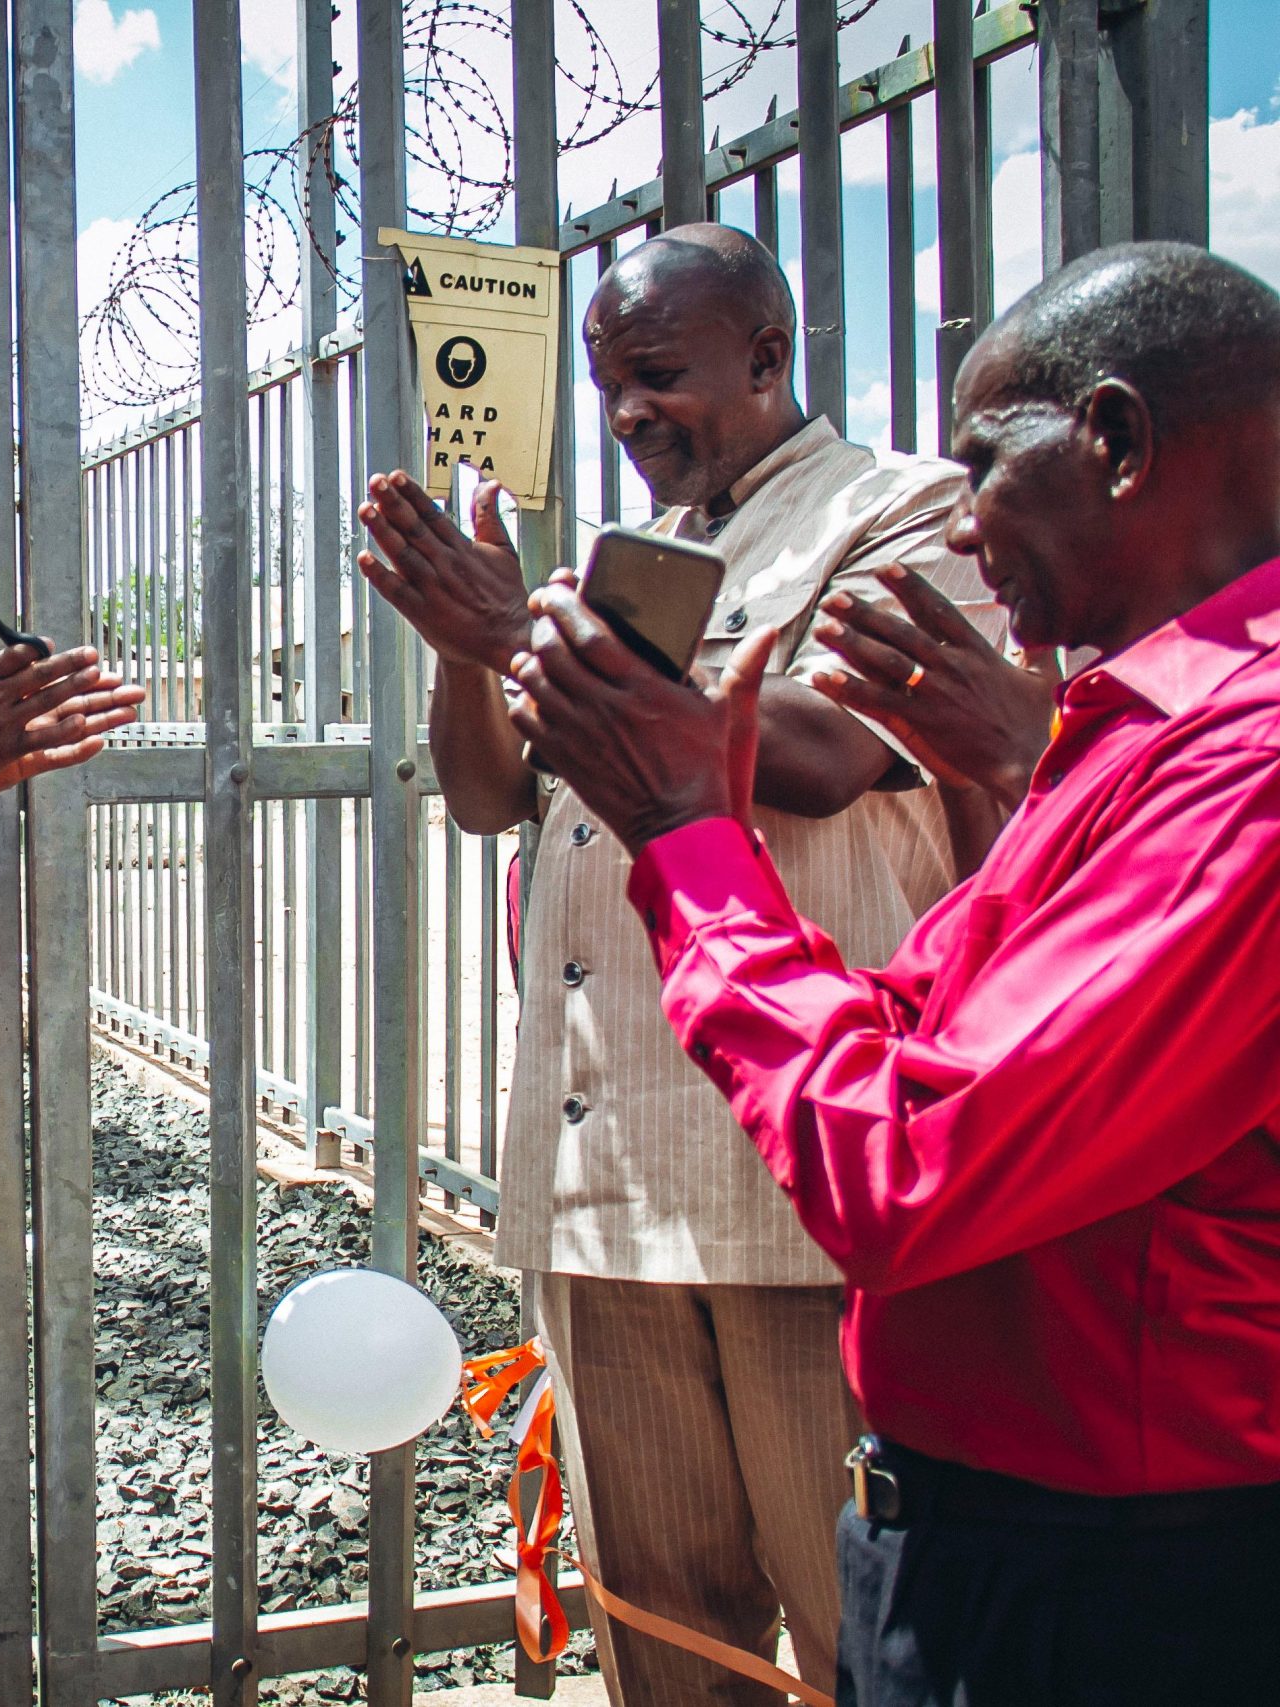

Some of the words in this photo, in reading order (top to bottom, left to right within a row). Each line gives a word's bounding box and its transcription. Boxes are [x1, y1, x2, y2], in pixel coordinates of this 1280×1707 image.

[439, 272, 536, 299] CAUTION
[424, 401, 498, 422] ARD
[427, 426, 487, 446] HAT
[433, 451, 495, 471] REA
